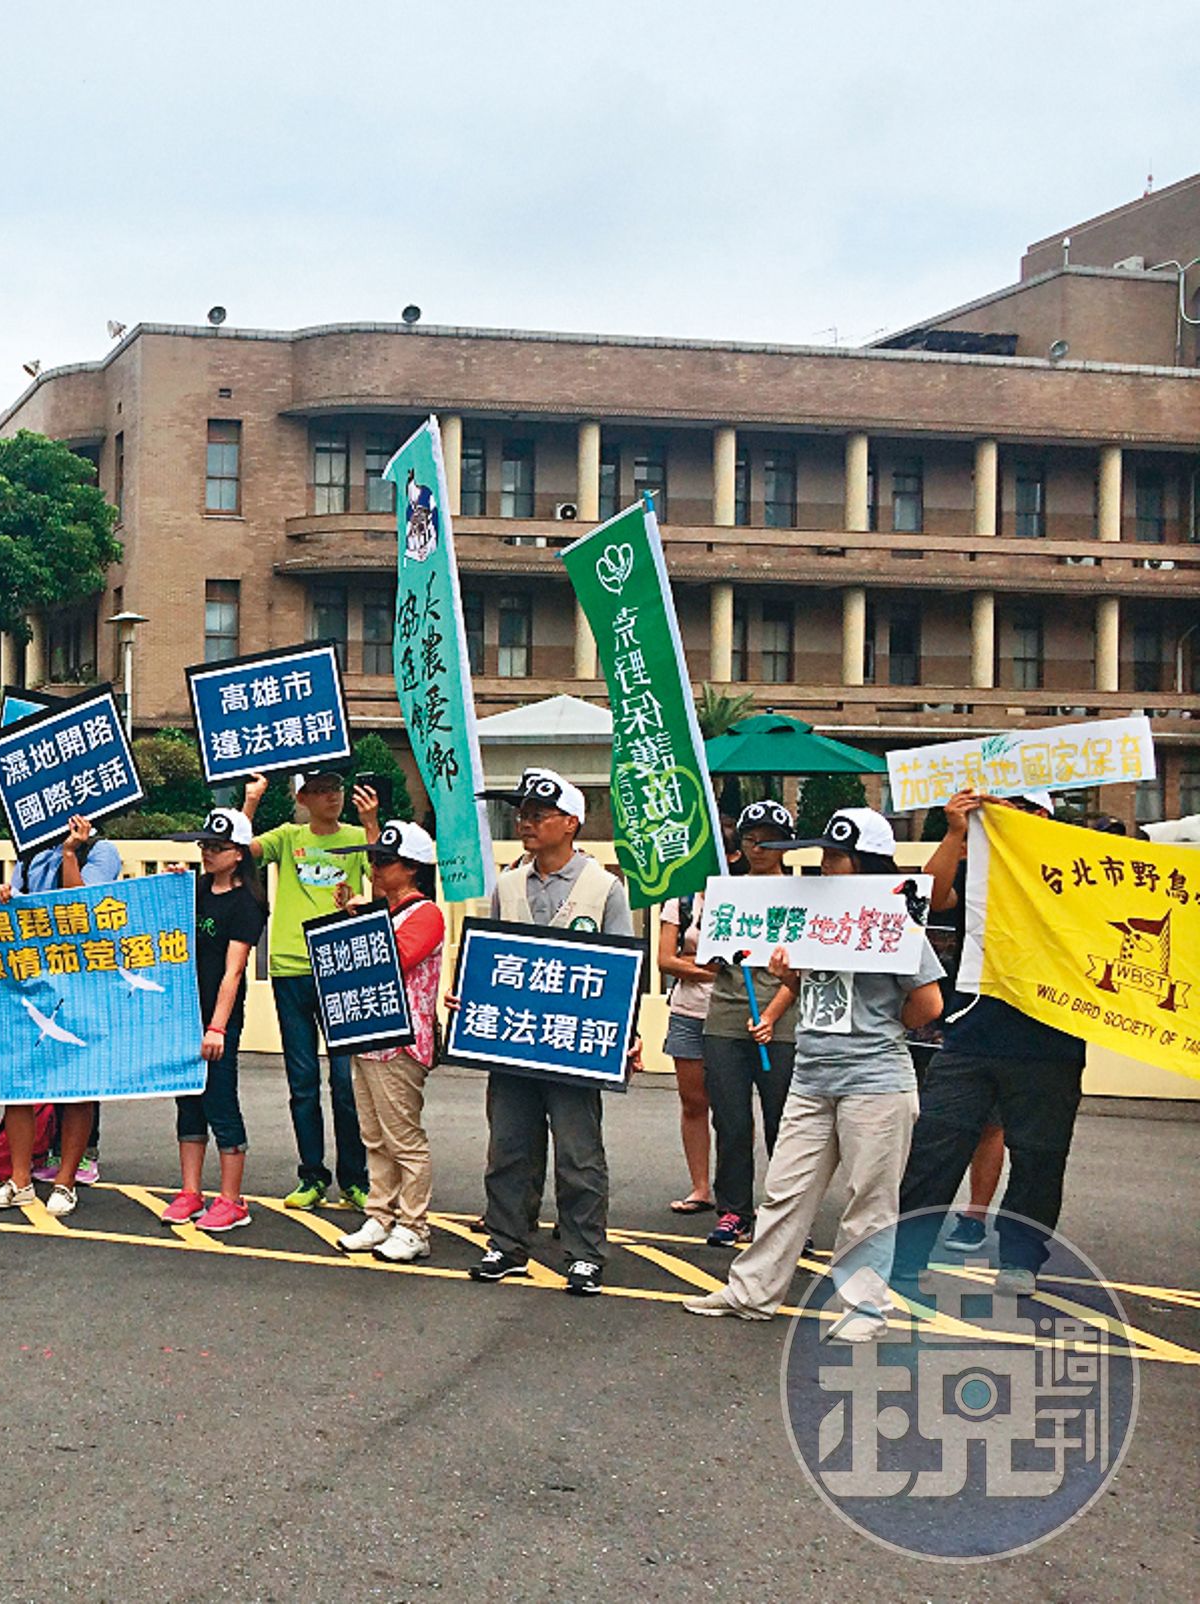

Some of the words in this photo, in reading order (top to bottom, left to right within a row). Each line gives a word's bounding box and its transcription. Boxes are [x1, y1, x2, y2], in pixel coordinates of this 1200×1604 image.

[218, 671, 312, 715] 高雄市
[0, 715, 114, 786] 濕地開路
[210, 710, 336, 761] 違法環評
[14, 756, 128, 830] 國際笑話
[1041, 856, 1200, 905] 台北市野鳥
[315, 930, 391, 977] 濕地開路
[491, 953, 607, 1000] 高雄市
[1116, 964, 1167, 991] WBST
[324, 980, 400, 1026] 國際笑話
[1036, 983, 1069, 1007] WILD
[1071, 998, 1101, 1019] BIRD
[1103, 1010, 1156, 1039] SOCIETY
[1159, 1029, 1178, 1046] OF
[462, 1001, 619, 1058] 違法環評
